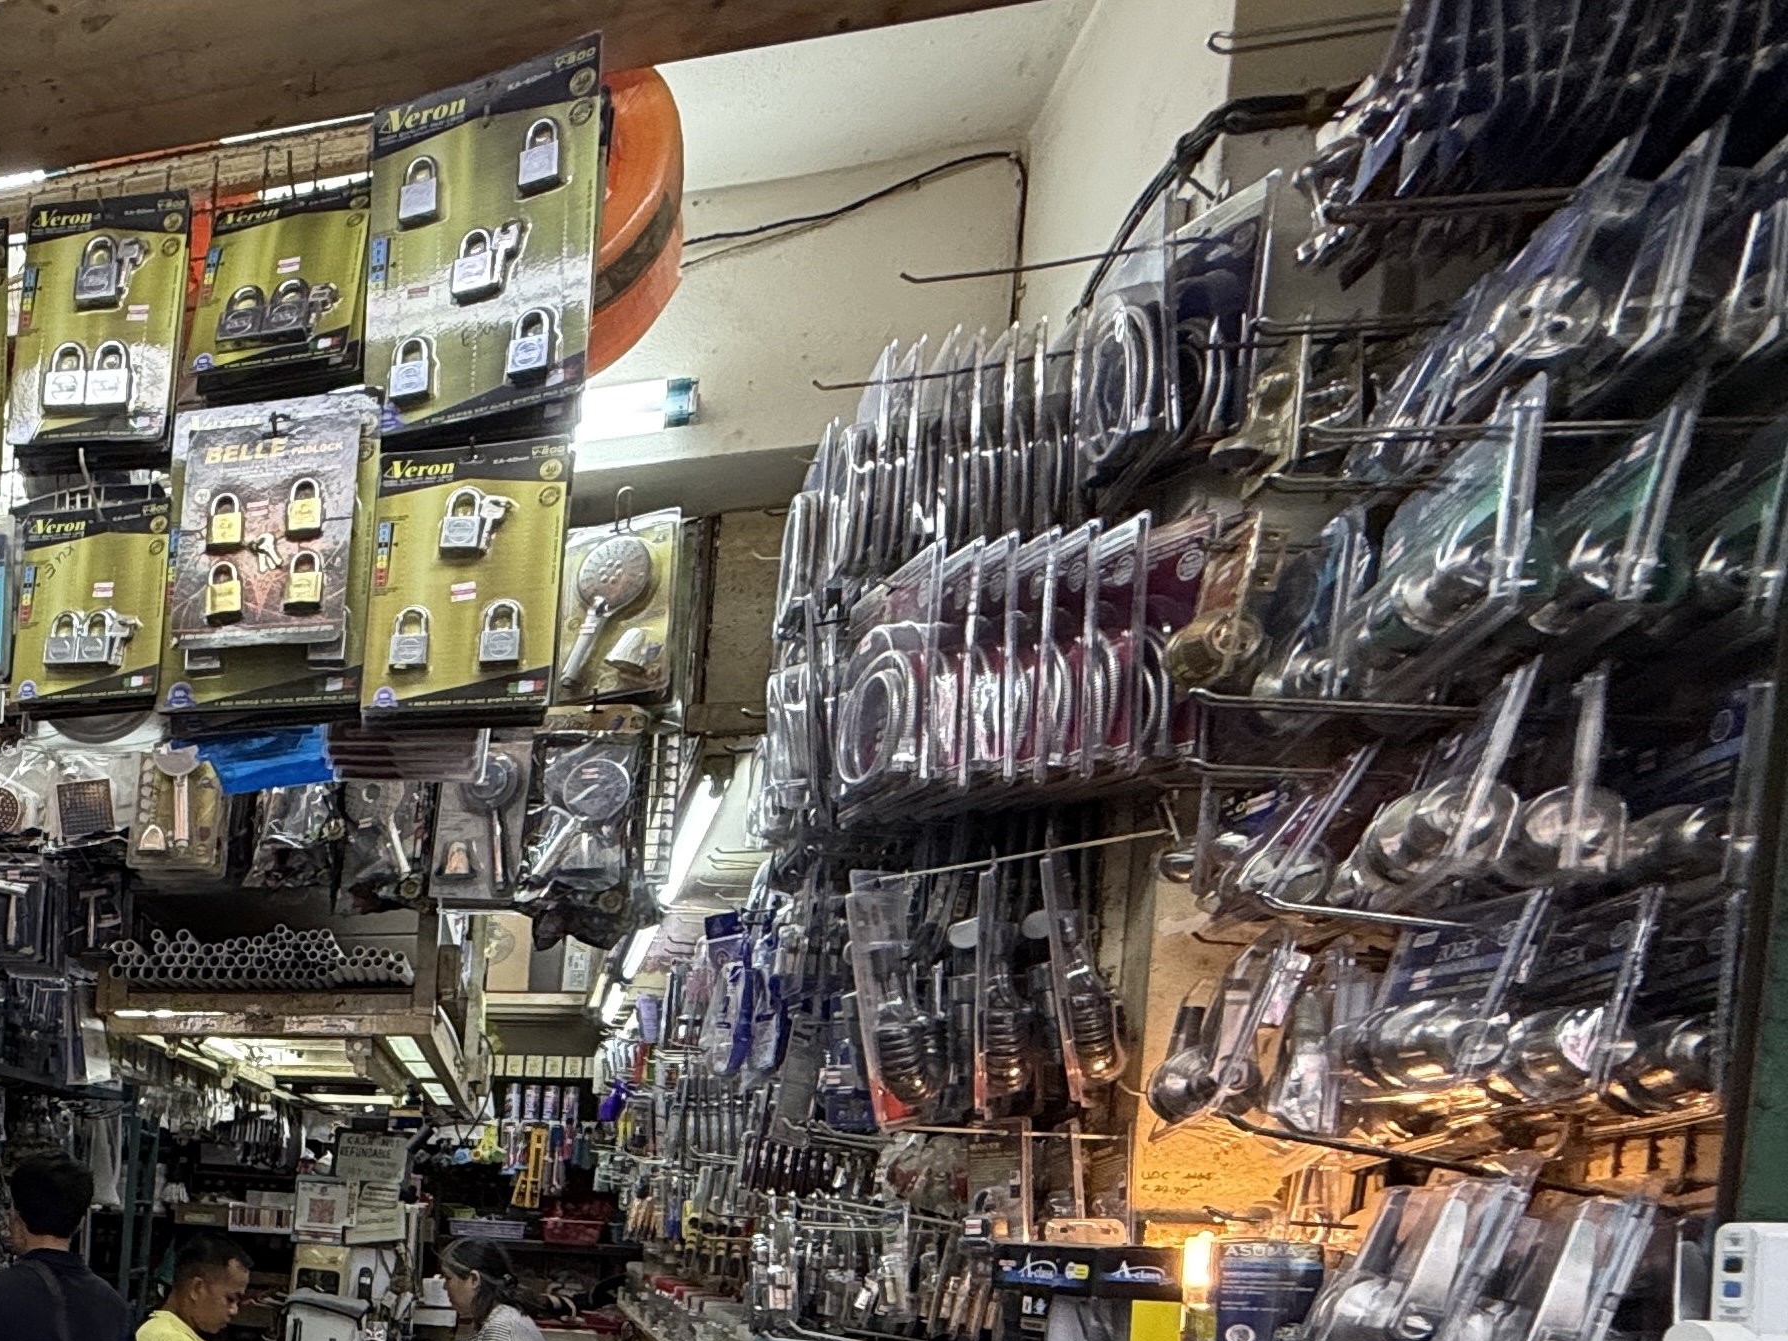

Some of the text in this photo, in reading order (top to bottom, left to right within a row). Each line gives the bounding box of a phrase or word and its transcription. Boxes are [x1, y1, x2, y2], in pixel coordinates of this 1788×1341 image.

[378, 97, 466, 134] Veron
[34, 209, 93, 229] Veron
[220, 207, 280, 226] Veron
[205, 437, 343, 465] BELLE PADLOCK
[383, 460, 455, 479] Veron
[29, 518, 86, 535] Veron
